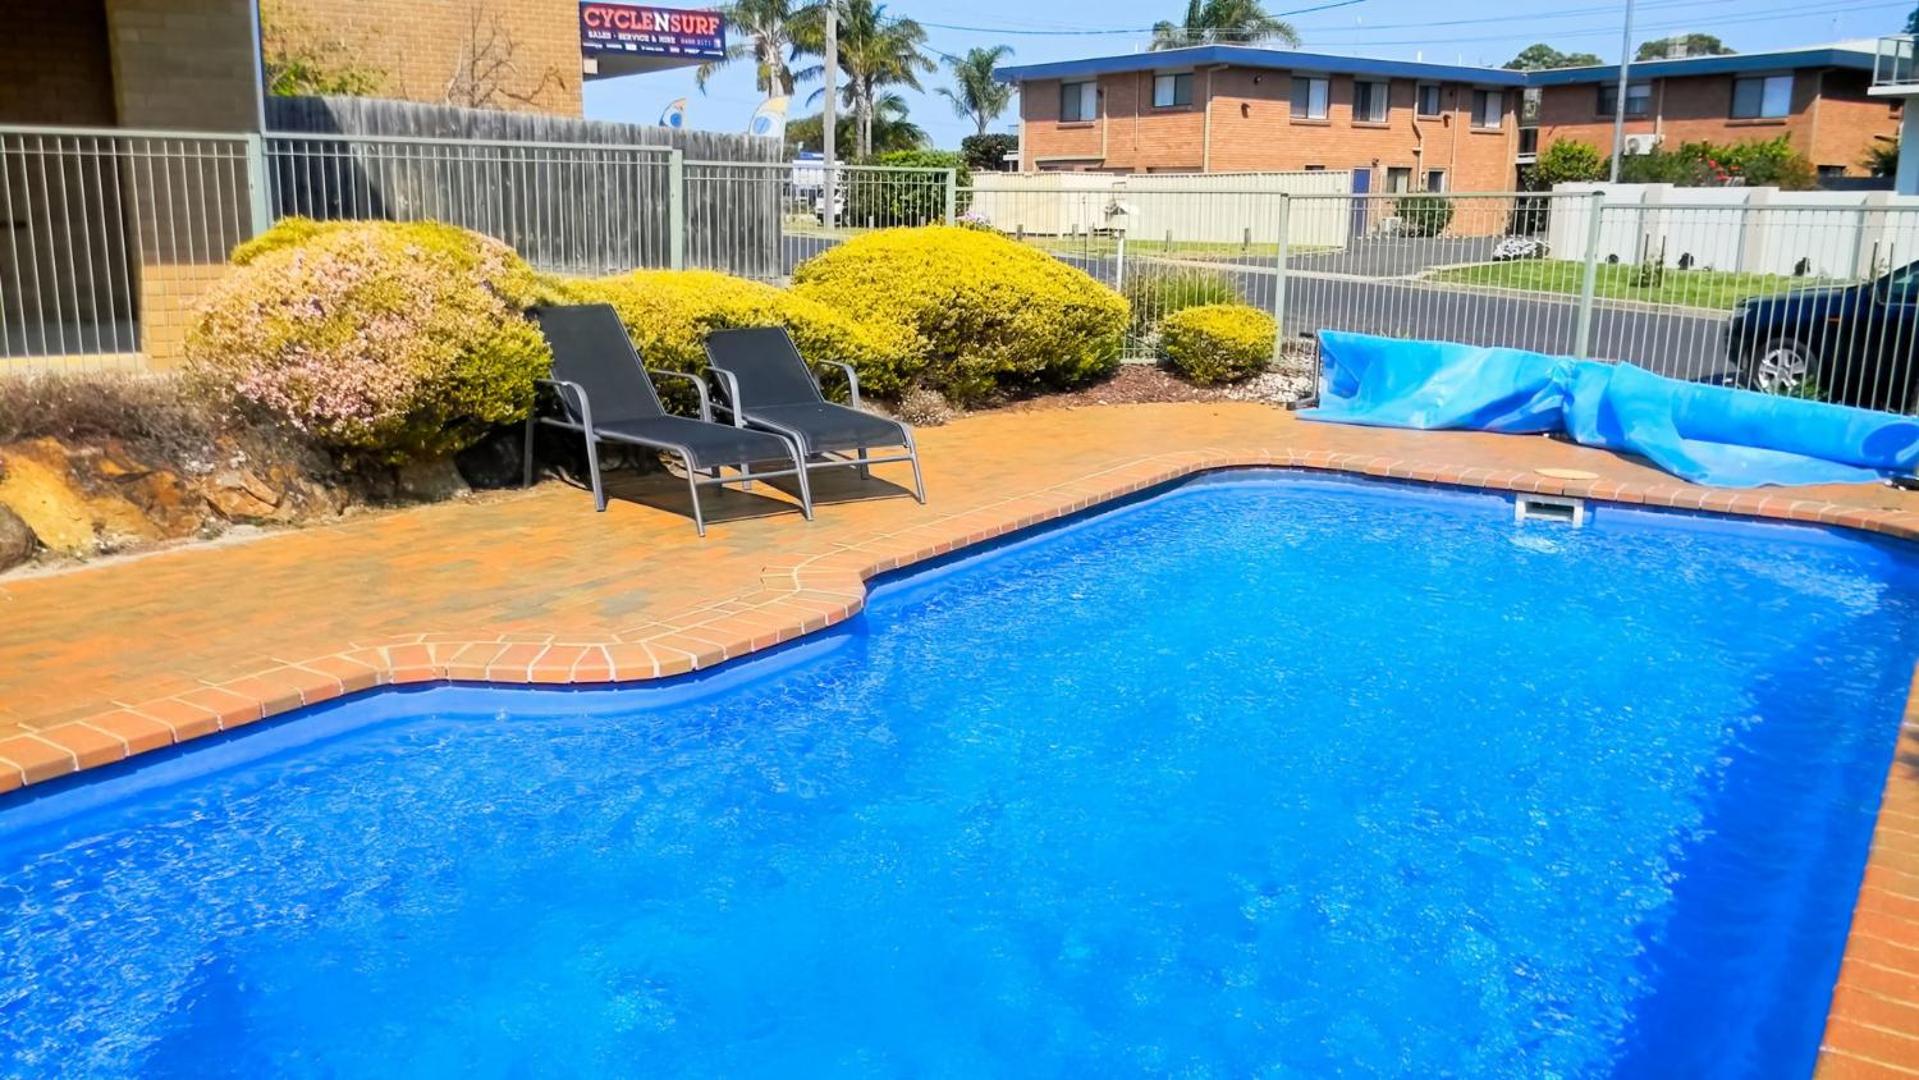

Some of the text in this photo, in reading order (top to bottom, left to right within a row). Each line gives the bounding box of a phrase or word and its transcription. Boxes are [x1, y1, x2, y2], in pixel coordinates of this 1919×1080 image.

[584, 7, 720, 35] CYCLENSURF
[588, 30, 611, 39] SALES
[618, 32, 649, 42] SERVICE
